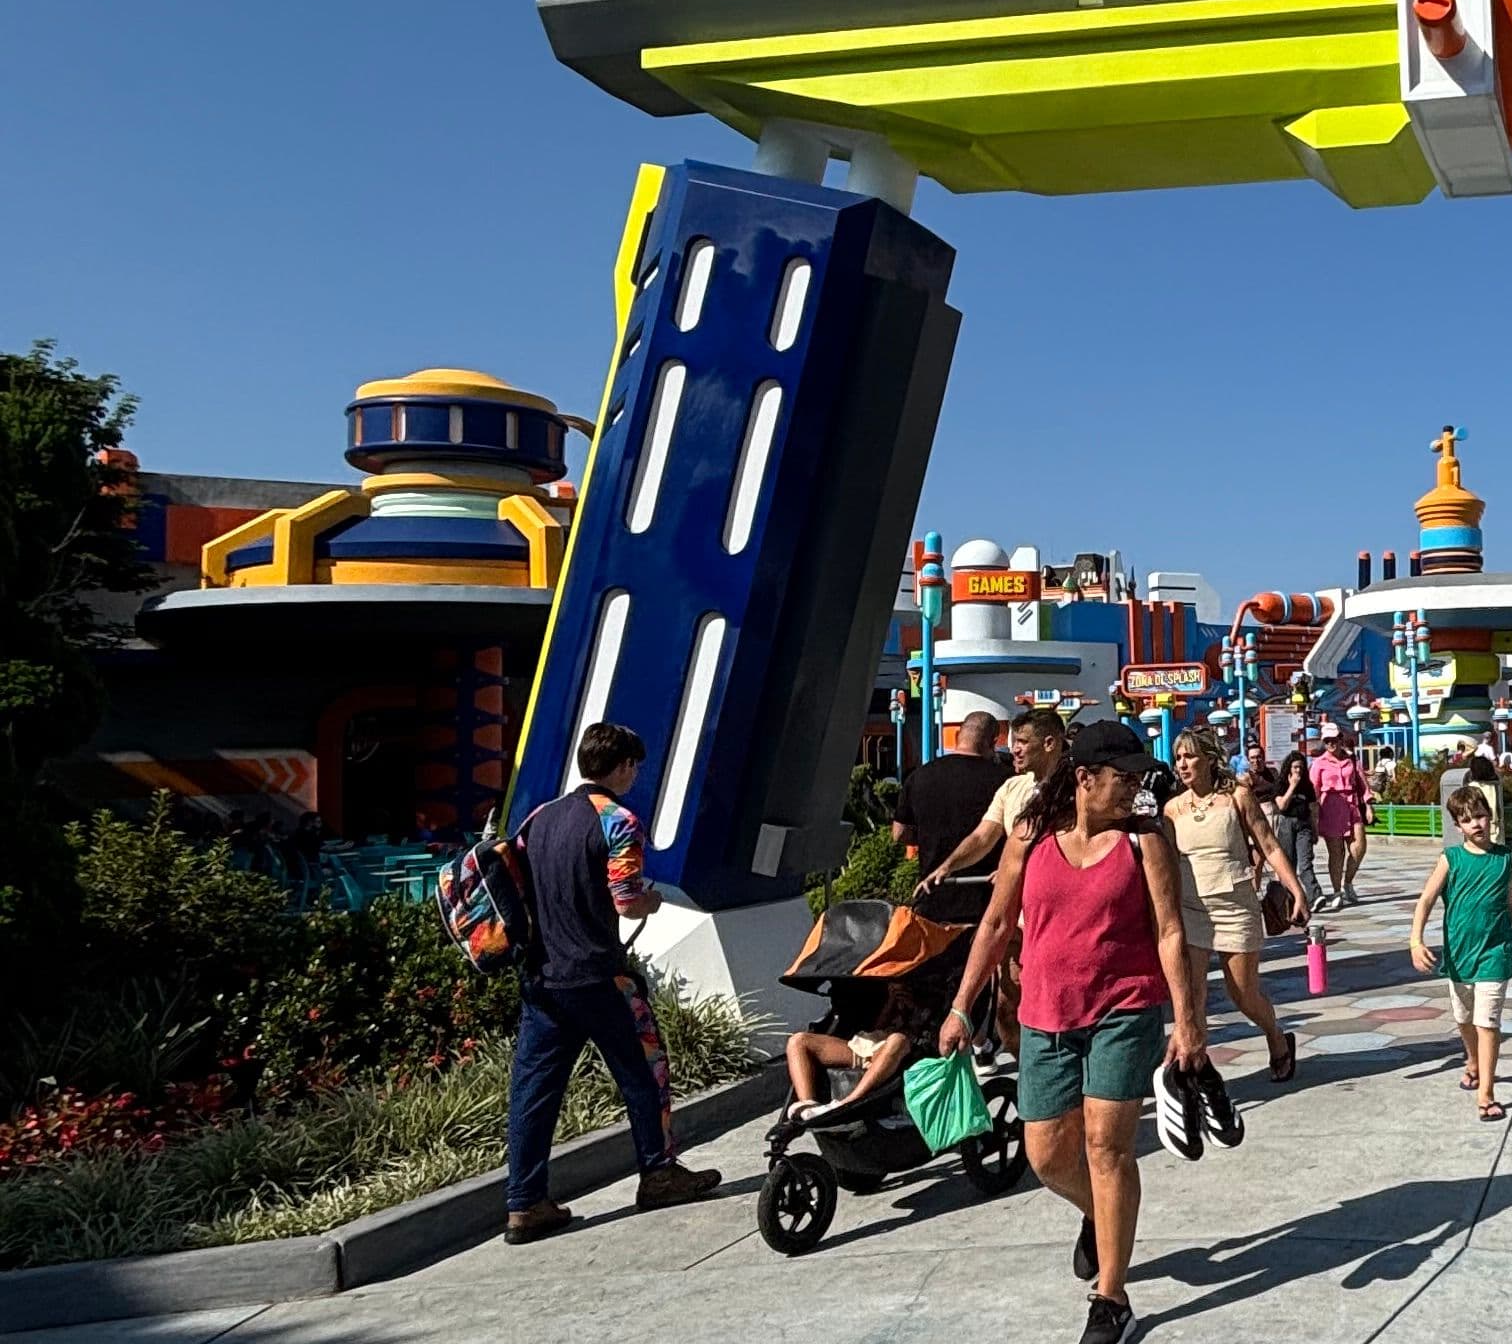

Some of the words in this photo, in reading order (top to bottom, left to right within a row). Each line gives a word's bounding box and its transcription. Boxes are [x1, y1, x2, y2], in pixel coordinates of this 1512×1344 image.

[968, 575, 1025, 594] GAMES
[1130, 674, 1153, 688] ZONA
[1167, 670, 1201, 684] SPLASH
